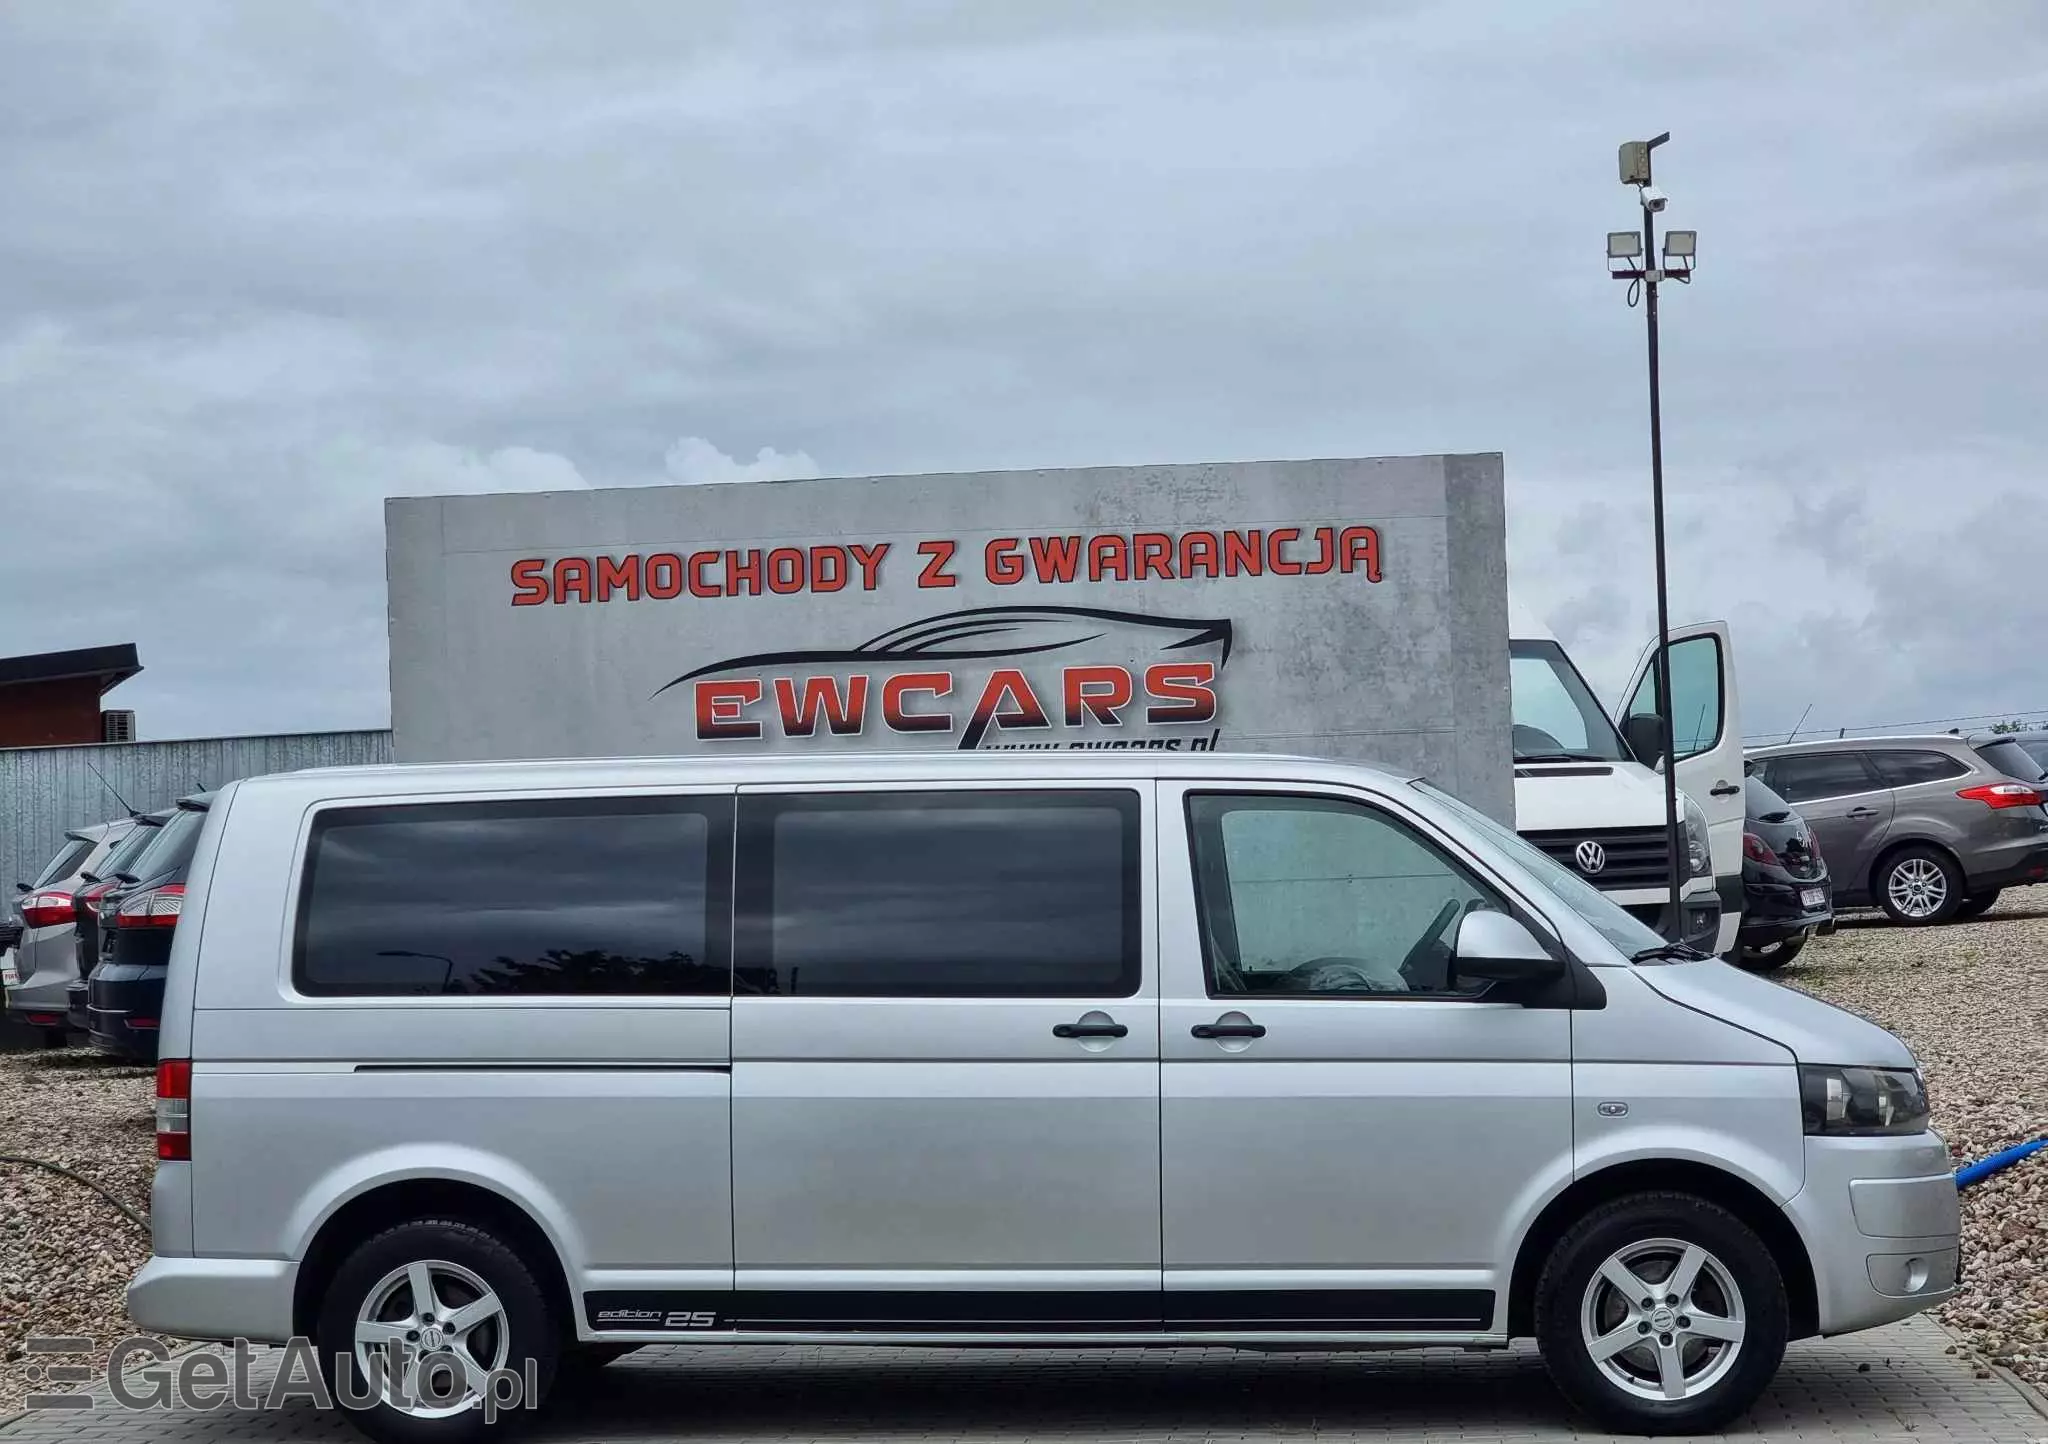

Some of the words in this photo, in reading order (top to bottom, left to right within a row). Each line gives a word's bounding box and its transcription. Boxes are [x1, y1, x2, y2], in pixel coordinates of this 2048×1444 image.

[511, 543, 891, 606] SAMOCHODY
[917, 540, 957, 588] Z
[984, 526, 1383, 584] GWARANCJĄ
[695, 663, 1216, 750] EWCARS
[597, 1309, 662, 1318] edition
[664, 1311, 717, 1327] 25
